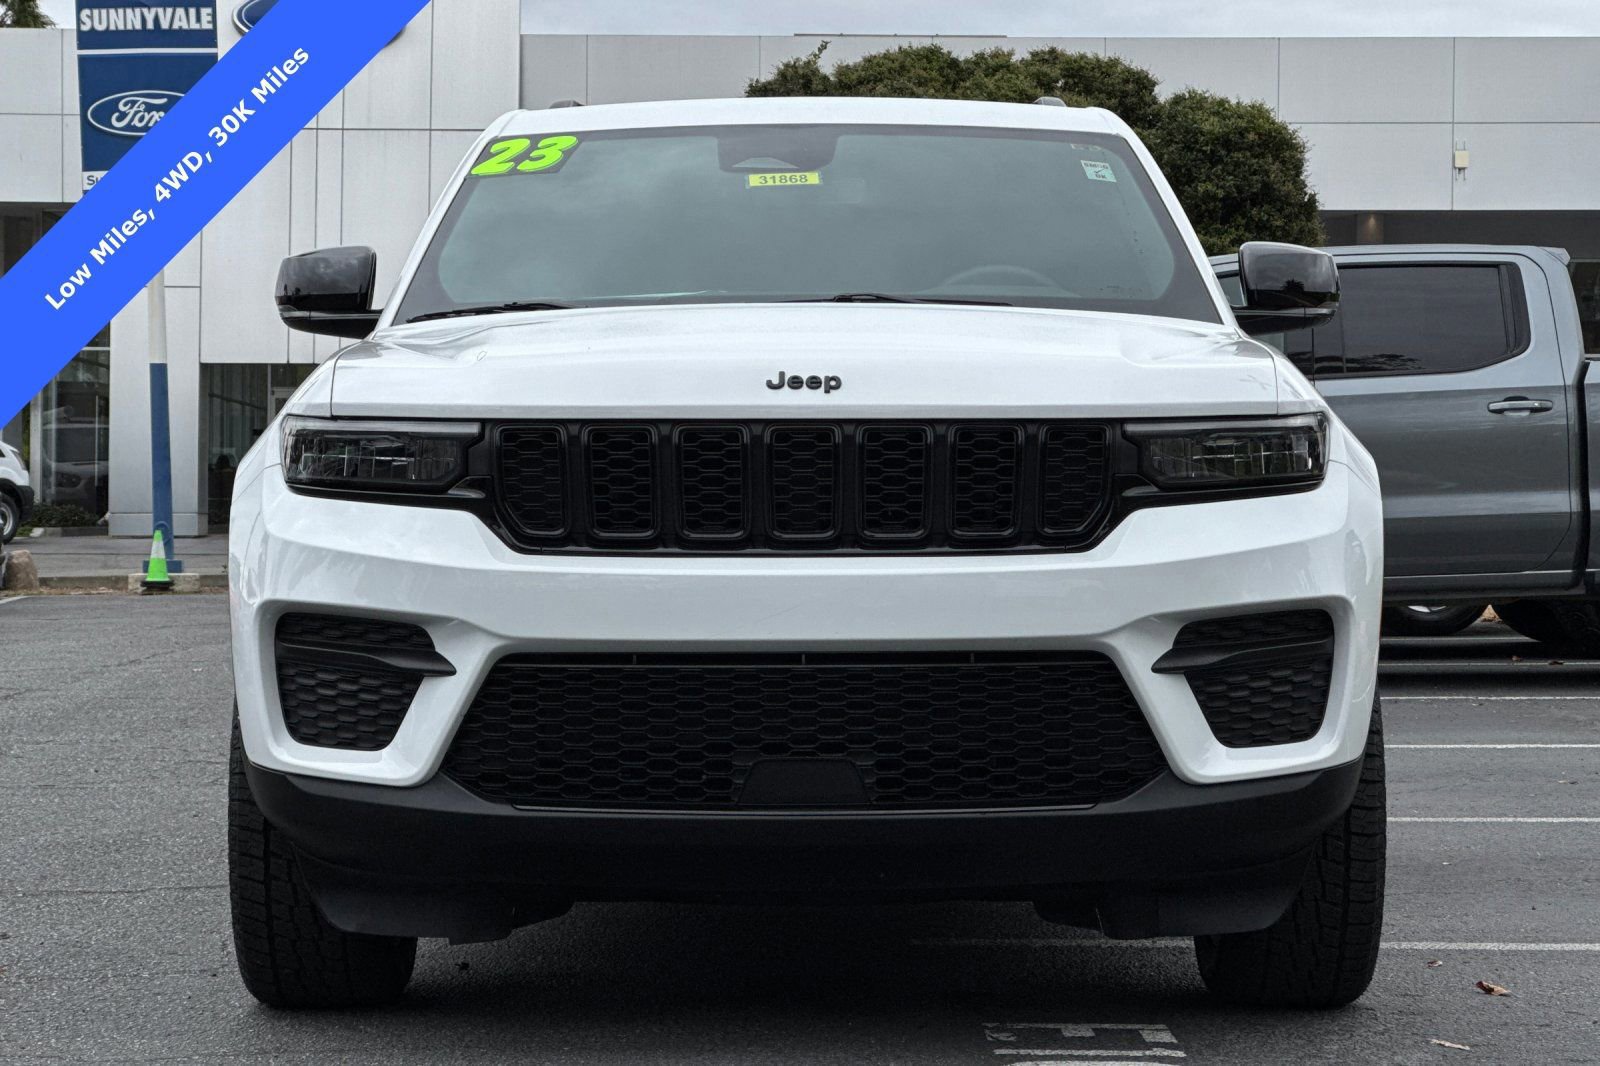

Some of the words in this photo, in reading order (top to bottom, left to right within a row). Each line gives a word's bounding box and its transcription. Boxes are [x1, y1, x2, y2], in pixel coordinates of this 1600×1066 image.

[79, 6, 213, 32] SUNNYVALE
[110, 96, 168, 128] For
[470, 135, 579, 176] 23
[758, 174, 809, 185] 31868
[765, 370, 842, 394] Jeep
